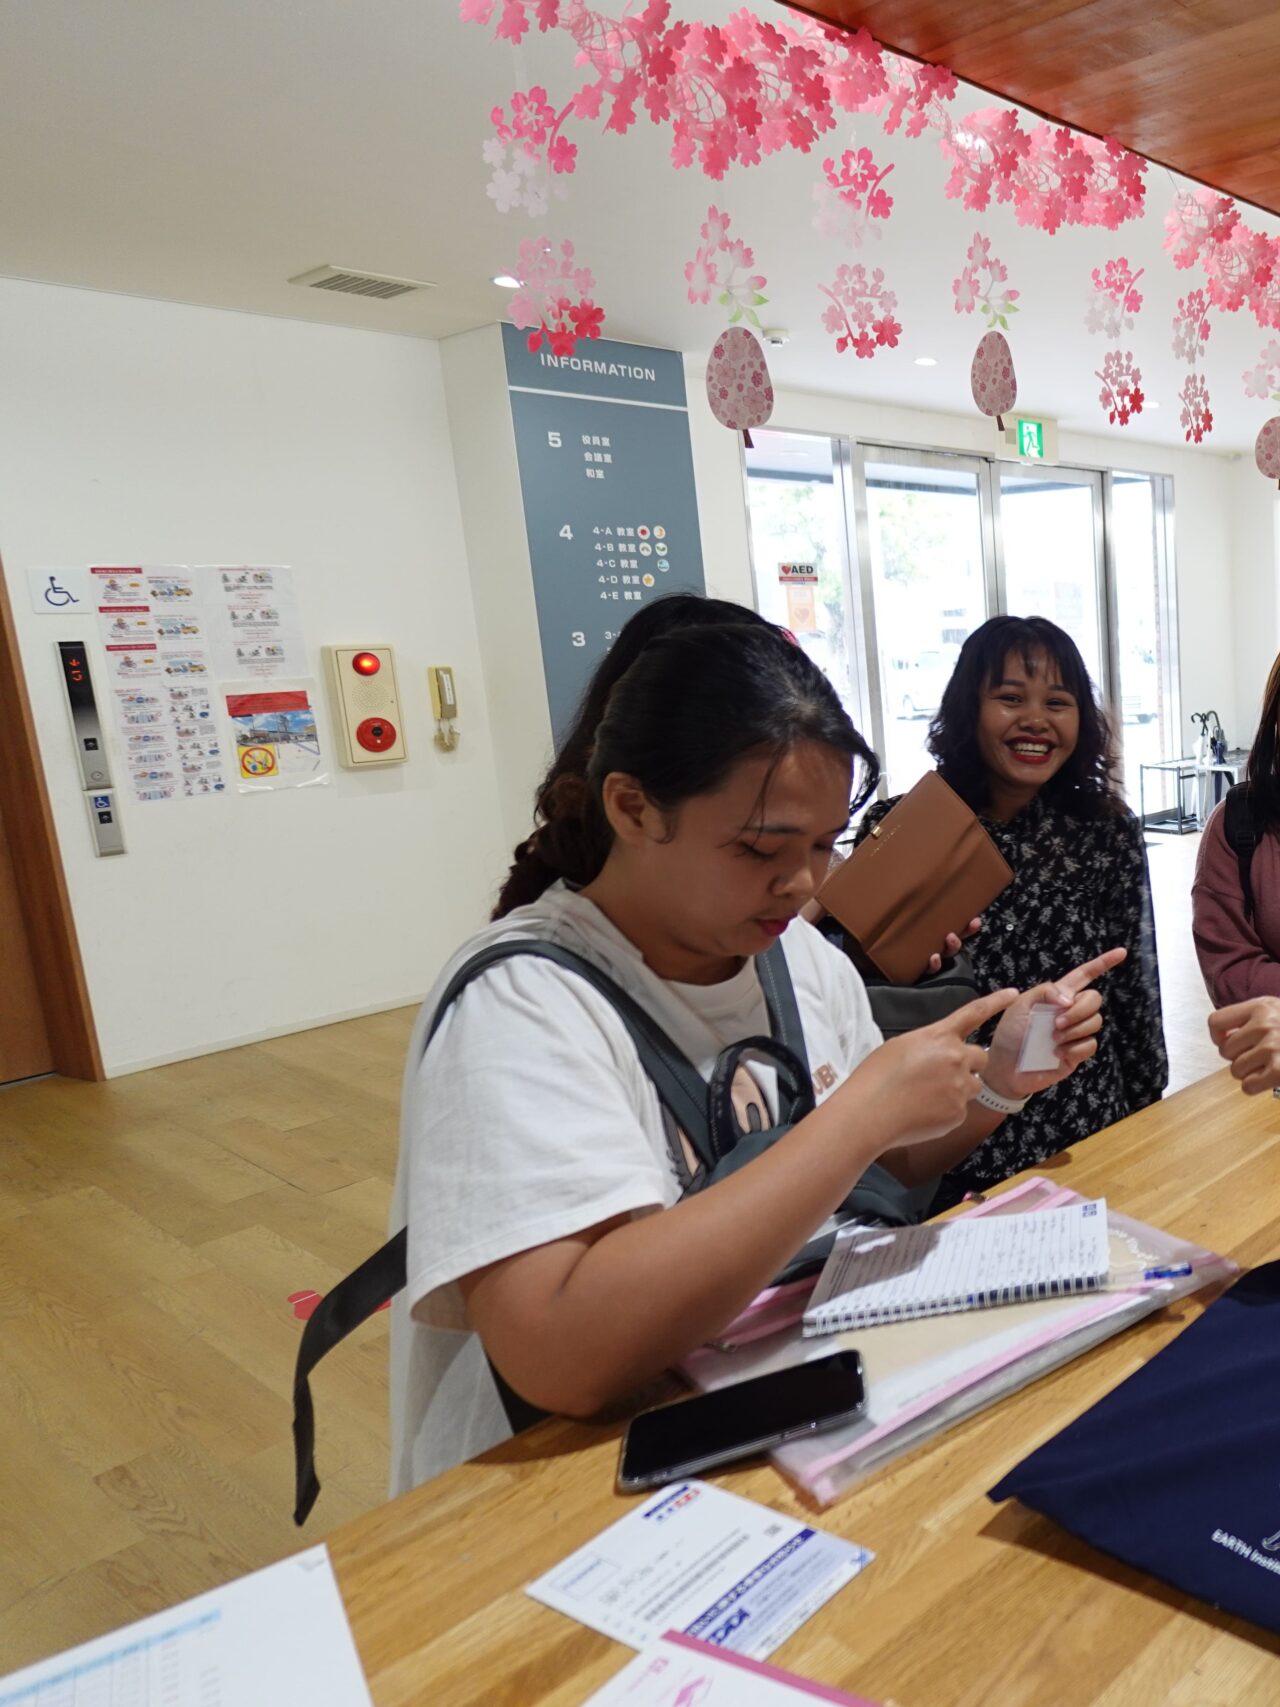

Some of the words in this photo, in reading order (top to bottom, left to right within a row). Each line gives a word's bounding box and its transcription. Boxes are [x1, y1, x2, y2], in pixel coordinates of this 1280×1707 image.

[540, 352, 656, 382] INFORMATION
[547, 431, 562, 448] 5
[559, 524, 574, 540] 4
[791, 565, 814, 574] AED
[571, 631, 586, 647] 3
[1211, 1528, 1252, 1558] EARTH
